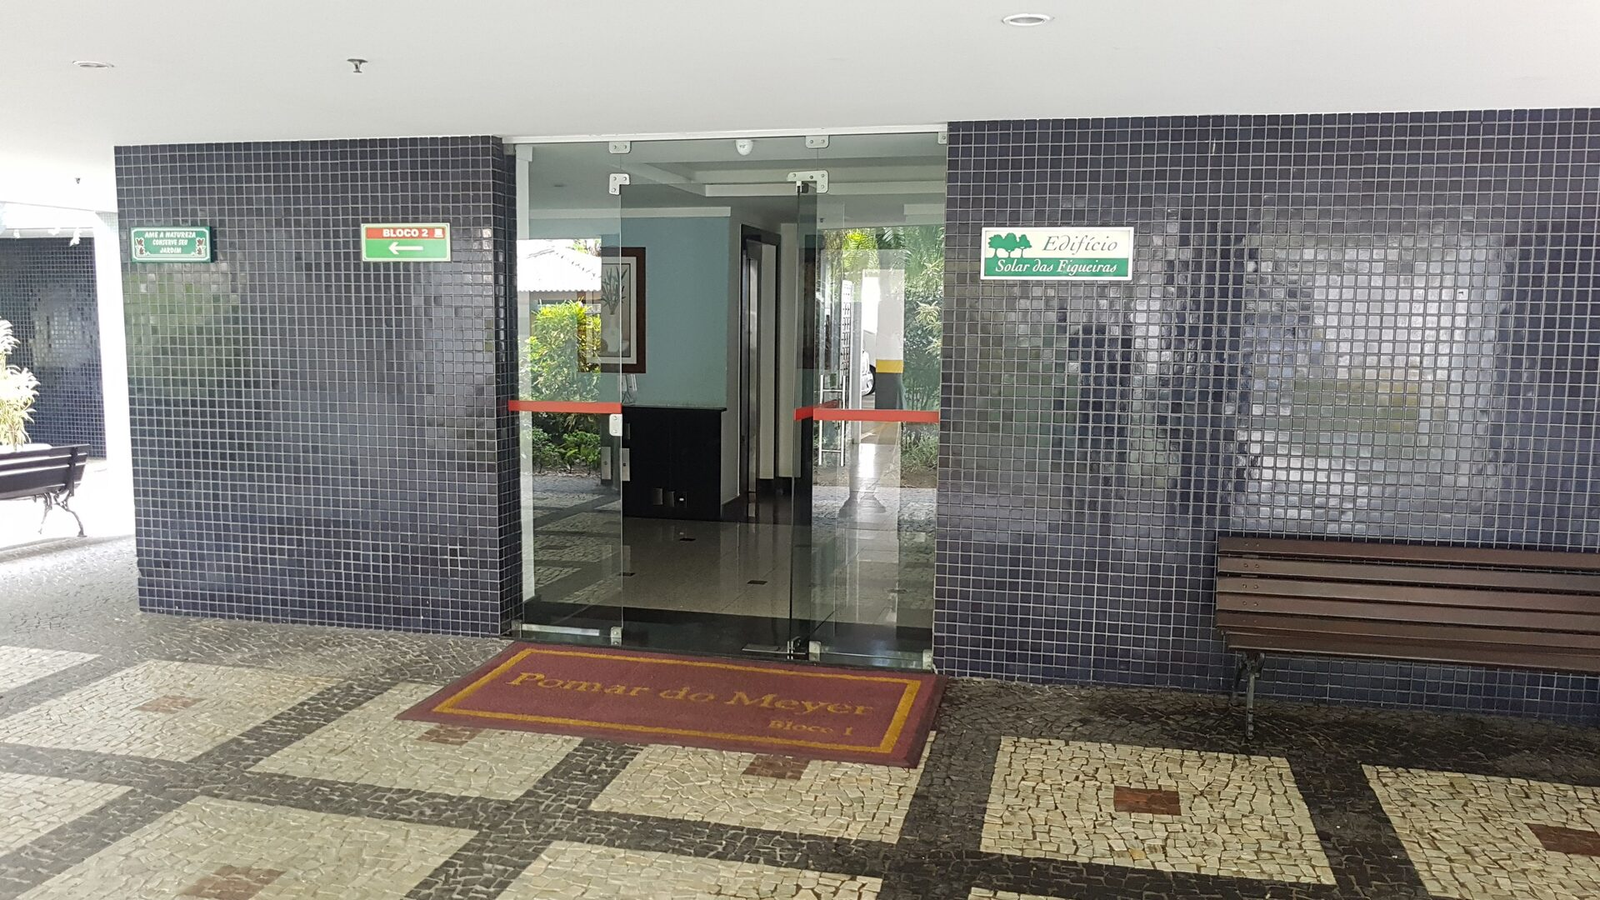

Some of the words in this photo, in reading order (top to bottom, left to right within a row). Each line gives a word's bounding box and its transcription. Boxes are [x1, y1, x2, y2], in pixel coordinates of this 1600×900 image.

[382, 228, 419, 238] BLOCO
[421, 228, 429, 238] 2
[1042, 234, 1118, 255] Edifício
[995, 258, 1030, 273] Solar
[1032, 258, 1054, 272] das
[1057, 259, 1118, 276] Figueiras
[506, 671, 650, 697] Pomar
[659, 686, 716, 703] do
[724, 690, 875, 716] Meyer
[768, 719, 834, 735] Bloco
